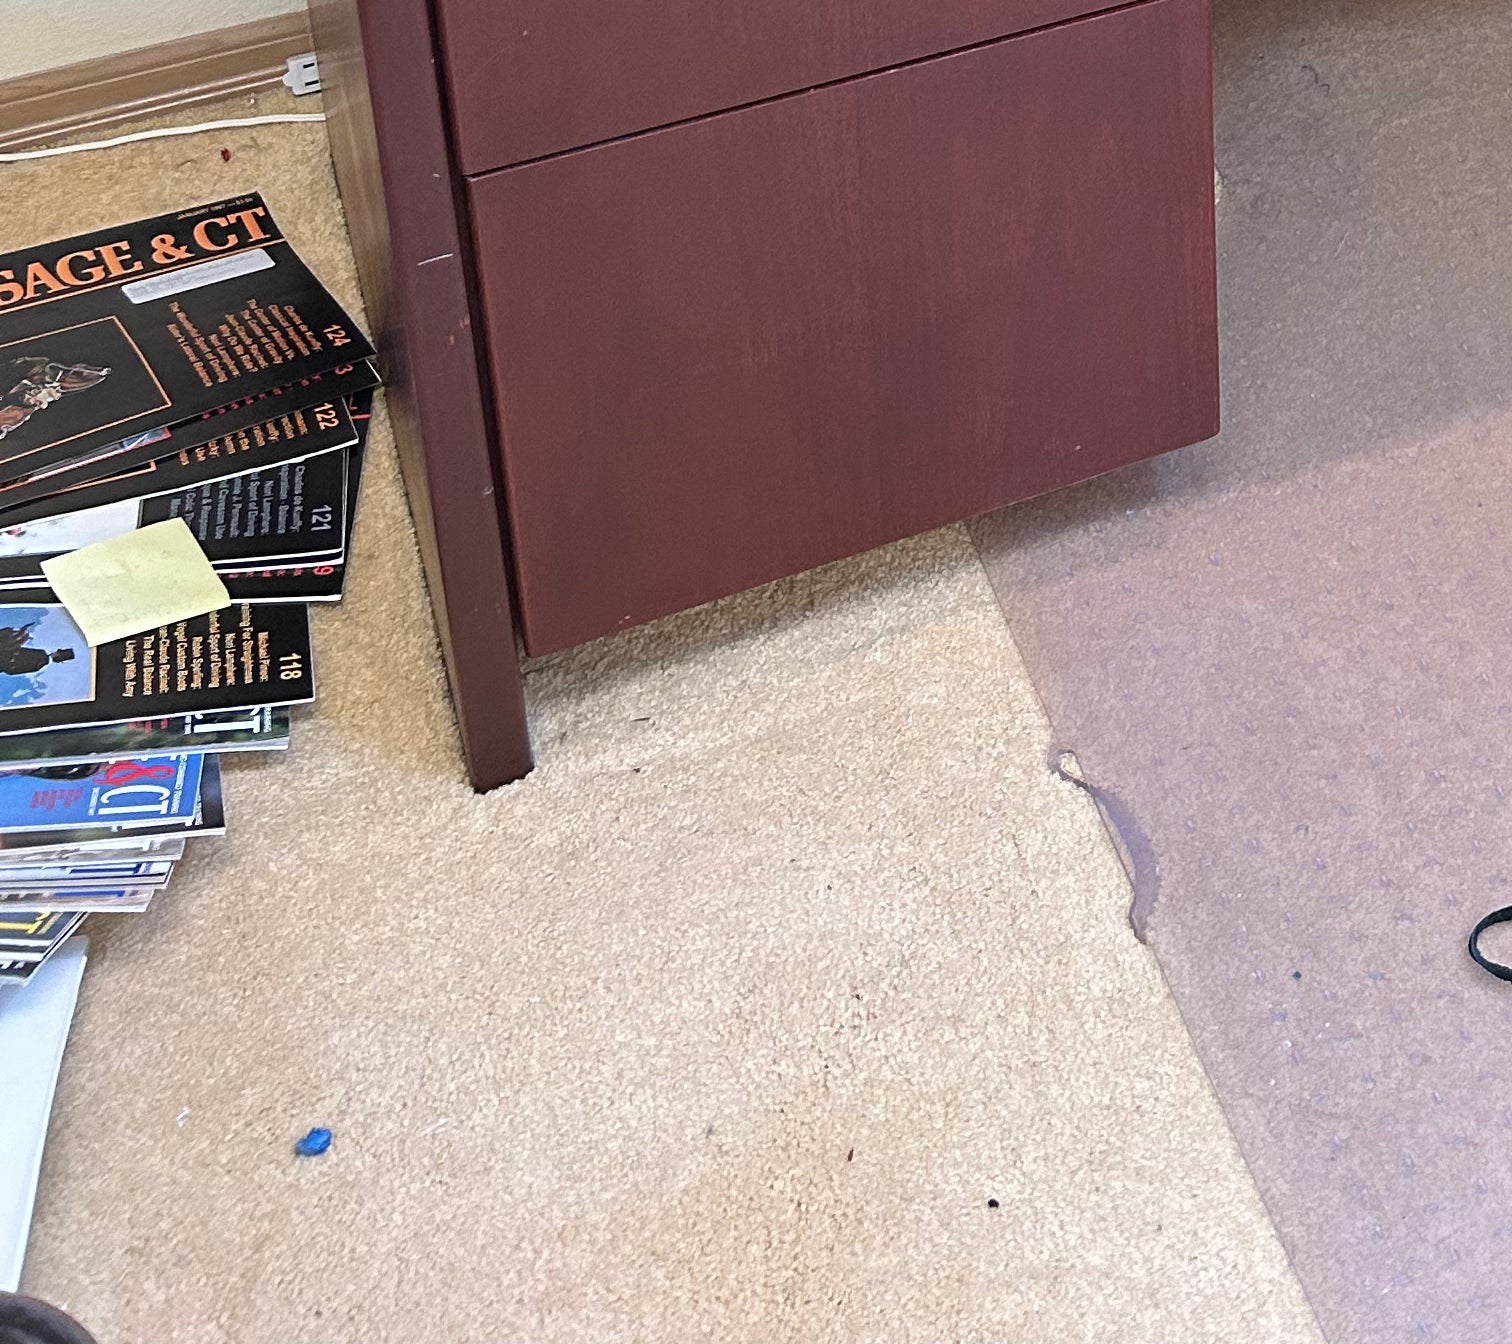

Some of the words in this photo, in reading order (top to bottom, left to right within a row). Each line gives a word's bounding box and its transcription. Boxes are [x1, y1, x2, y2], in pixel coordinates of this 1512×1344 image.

[150, 233, 195, 264] &
[193, 206, 271, 252] CT
[324, 323, 352, 347] 124
[314, 403, 339, 430] 122
[311, 505, 332, 531] 121
[279, 653, 302, 680] 118
[98, 785, 170, 815] CT
